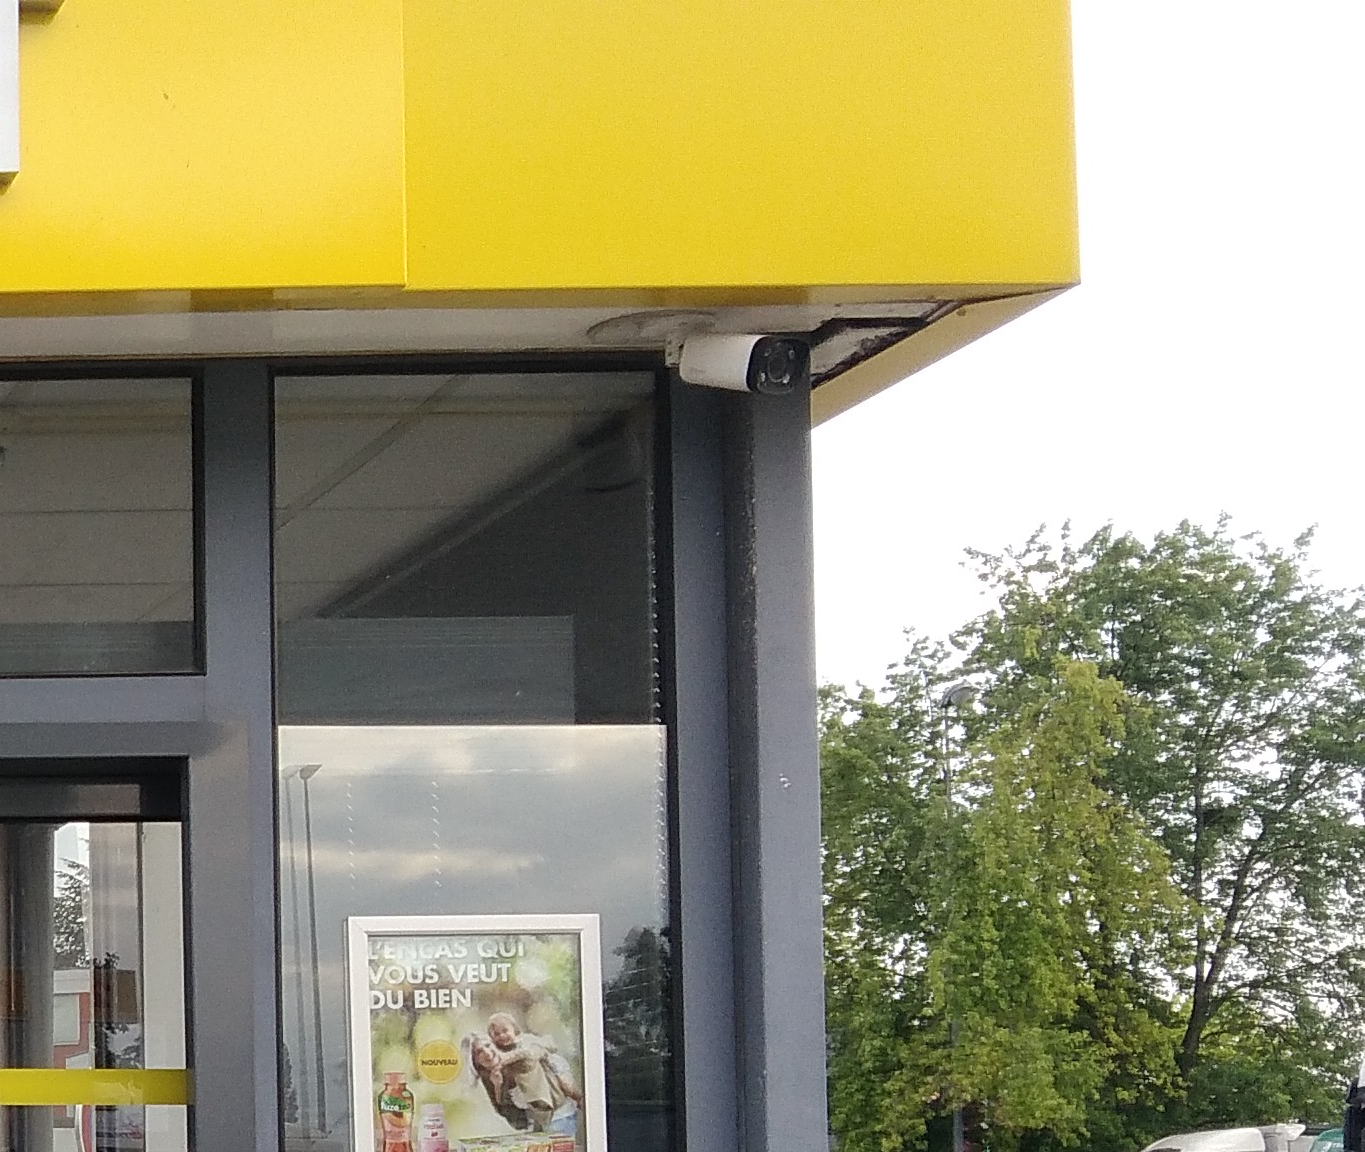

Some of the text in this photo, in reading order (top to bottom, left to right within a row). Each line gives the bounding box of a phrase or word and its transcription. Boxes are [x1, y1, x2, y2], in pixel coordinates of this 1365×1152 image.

[477, 940, 525, 959] QUI
[369, 963, 512, 985] VOUS VEUT
[370, 988, 472, 1010] DU BIEN
[421, 1058, 459, 1067] NOUVEAU
